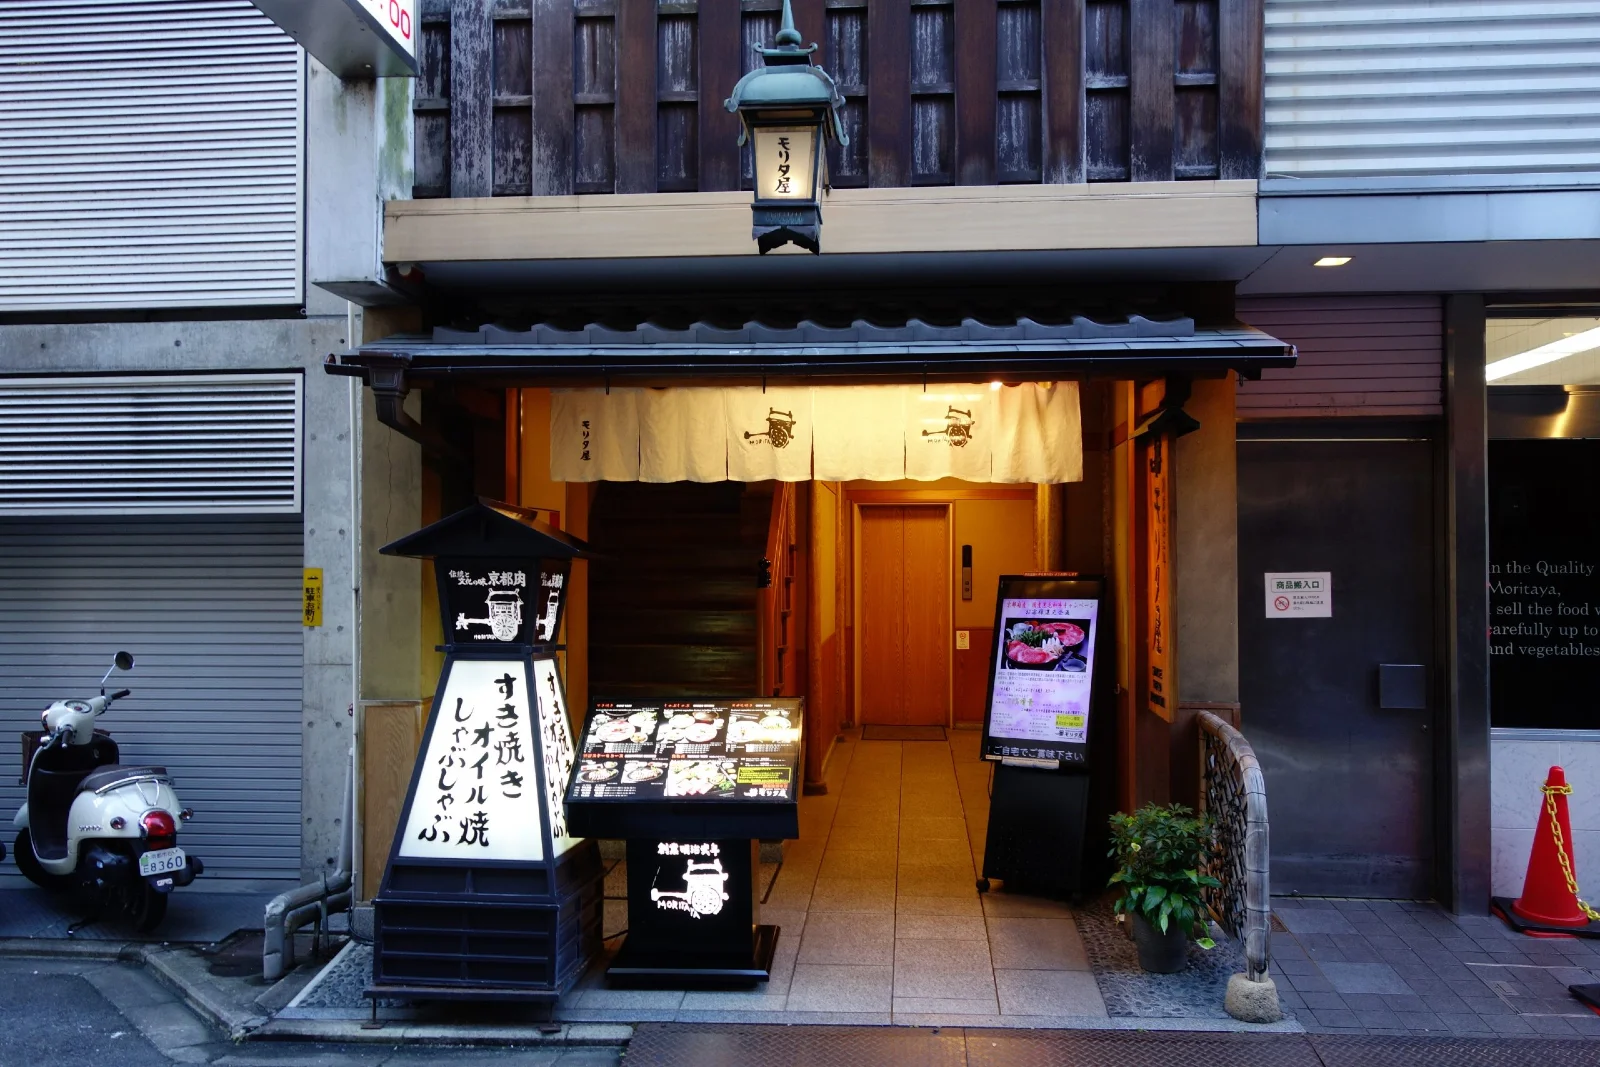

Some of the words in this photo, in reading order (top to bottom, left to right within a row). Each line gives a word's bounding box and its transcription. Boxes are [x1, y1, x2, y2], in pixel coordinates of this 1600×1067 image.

[775, 137, 791, 194] モリタ屋
[581, 420, 592, 461] モリタ屋
[1489, 563, 1501, 573] n
[1506, 561, 1531, 573] the
[1536, 561, 1594, 577] Quality
[488, 571, 526, 588] 京都肉
[1276, 580, 1320, 590] 商品搬入口
[1496, 602, 1523, 615] sell
[1528, 603, 1553, 615] the
[1558, 602, 1589, 616] food
[1559, 627, 1578, 638] up
[1584, 625, 1598, 635] to
[1519, 642, 1600, 659] vegetables
[494, 672, 525, 798] すき焼き
[418, 697, 476, 843] しゃぶしゃぶ
[455, 721, 495, 847] オイル焼
[150, 855, 183, 872] 8360
